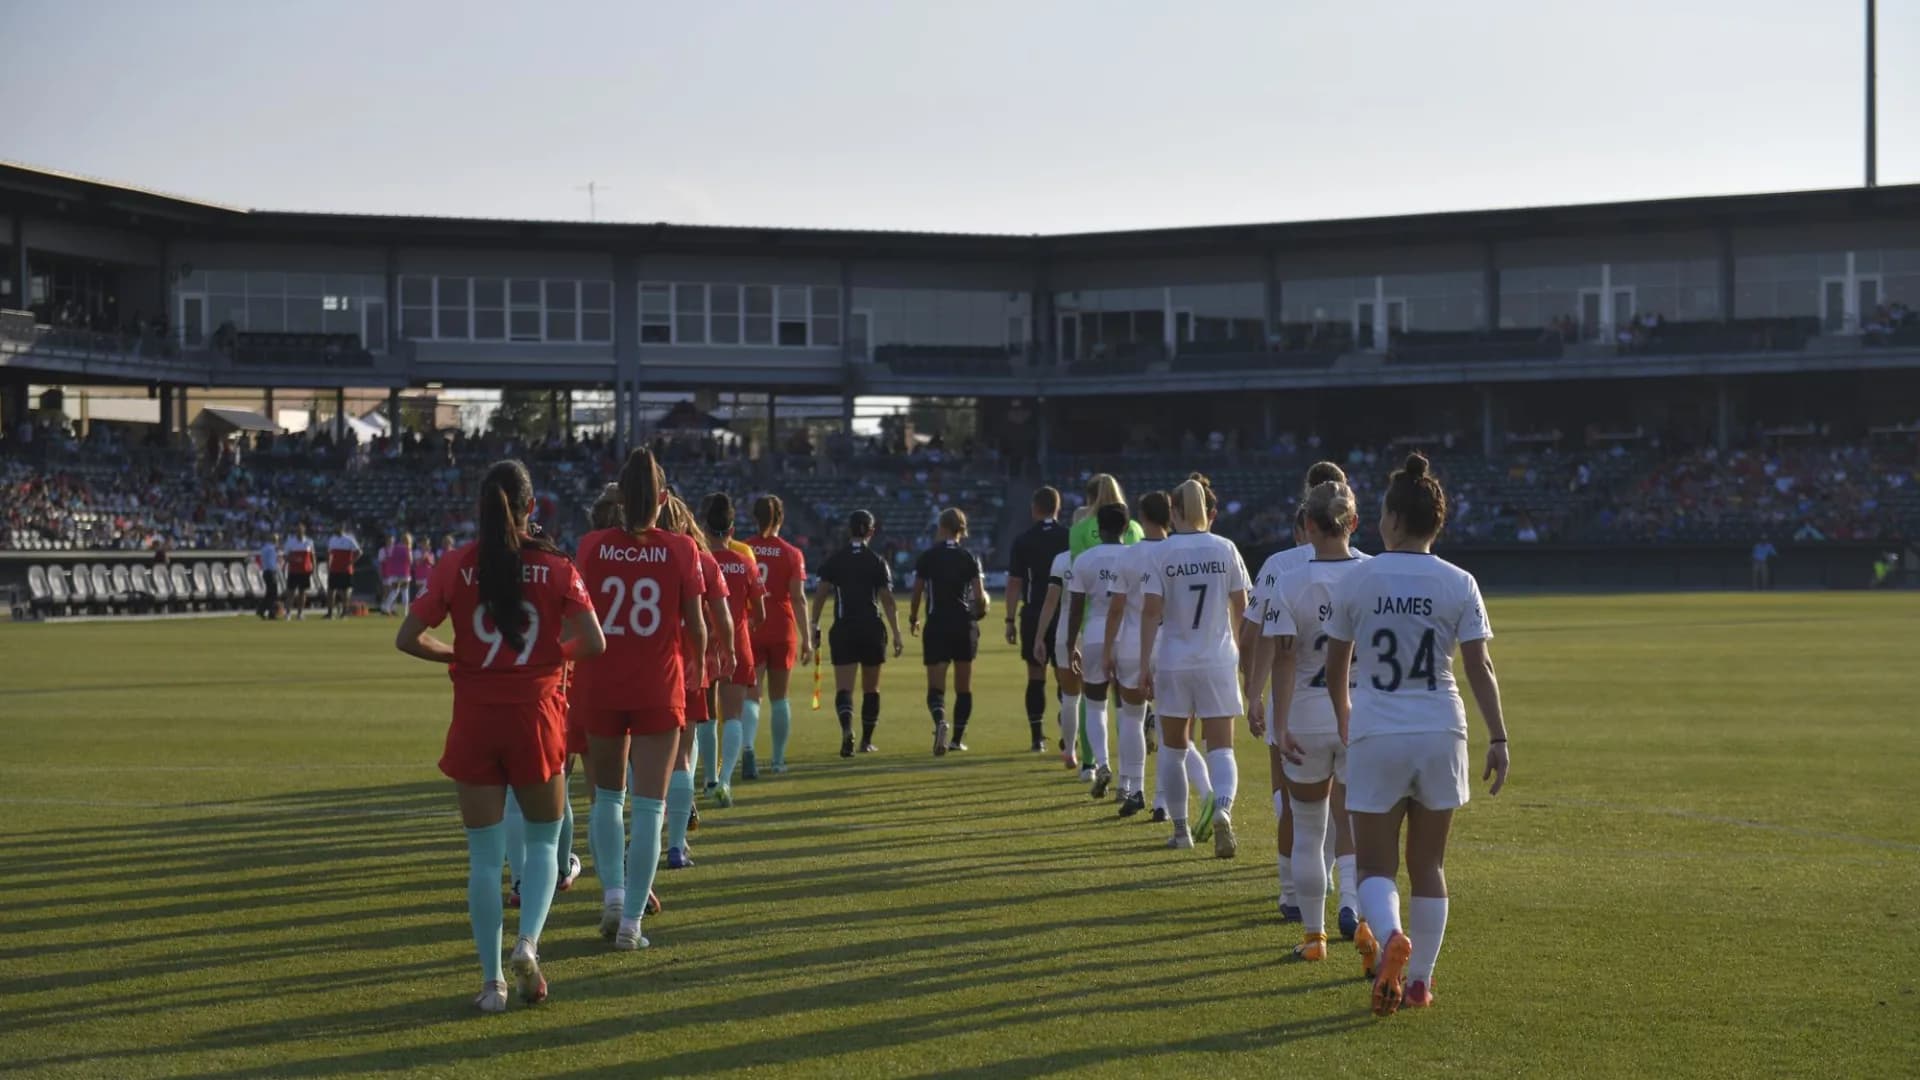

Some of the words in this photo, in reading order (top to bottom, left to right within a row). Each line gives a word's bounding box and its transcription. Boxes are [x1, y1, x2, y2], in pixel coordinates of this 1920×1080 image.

[600, 544, 667, 562] McCAIN
[752, 545, 781, 556] ORSIE
[720, 563, 745, 574] ONDS
[1166, 562, 1226, 577] CALDWELL
[601, 576, 661, 637] 28
[1189, 584, 1208, 630] 7
[1374, 596, 1432, 616] JAMES
[473, 601, 539, 669] 99
[1371, 628, 1437, 692] 34
